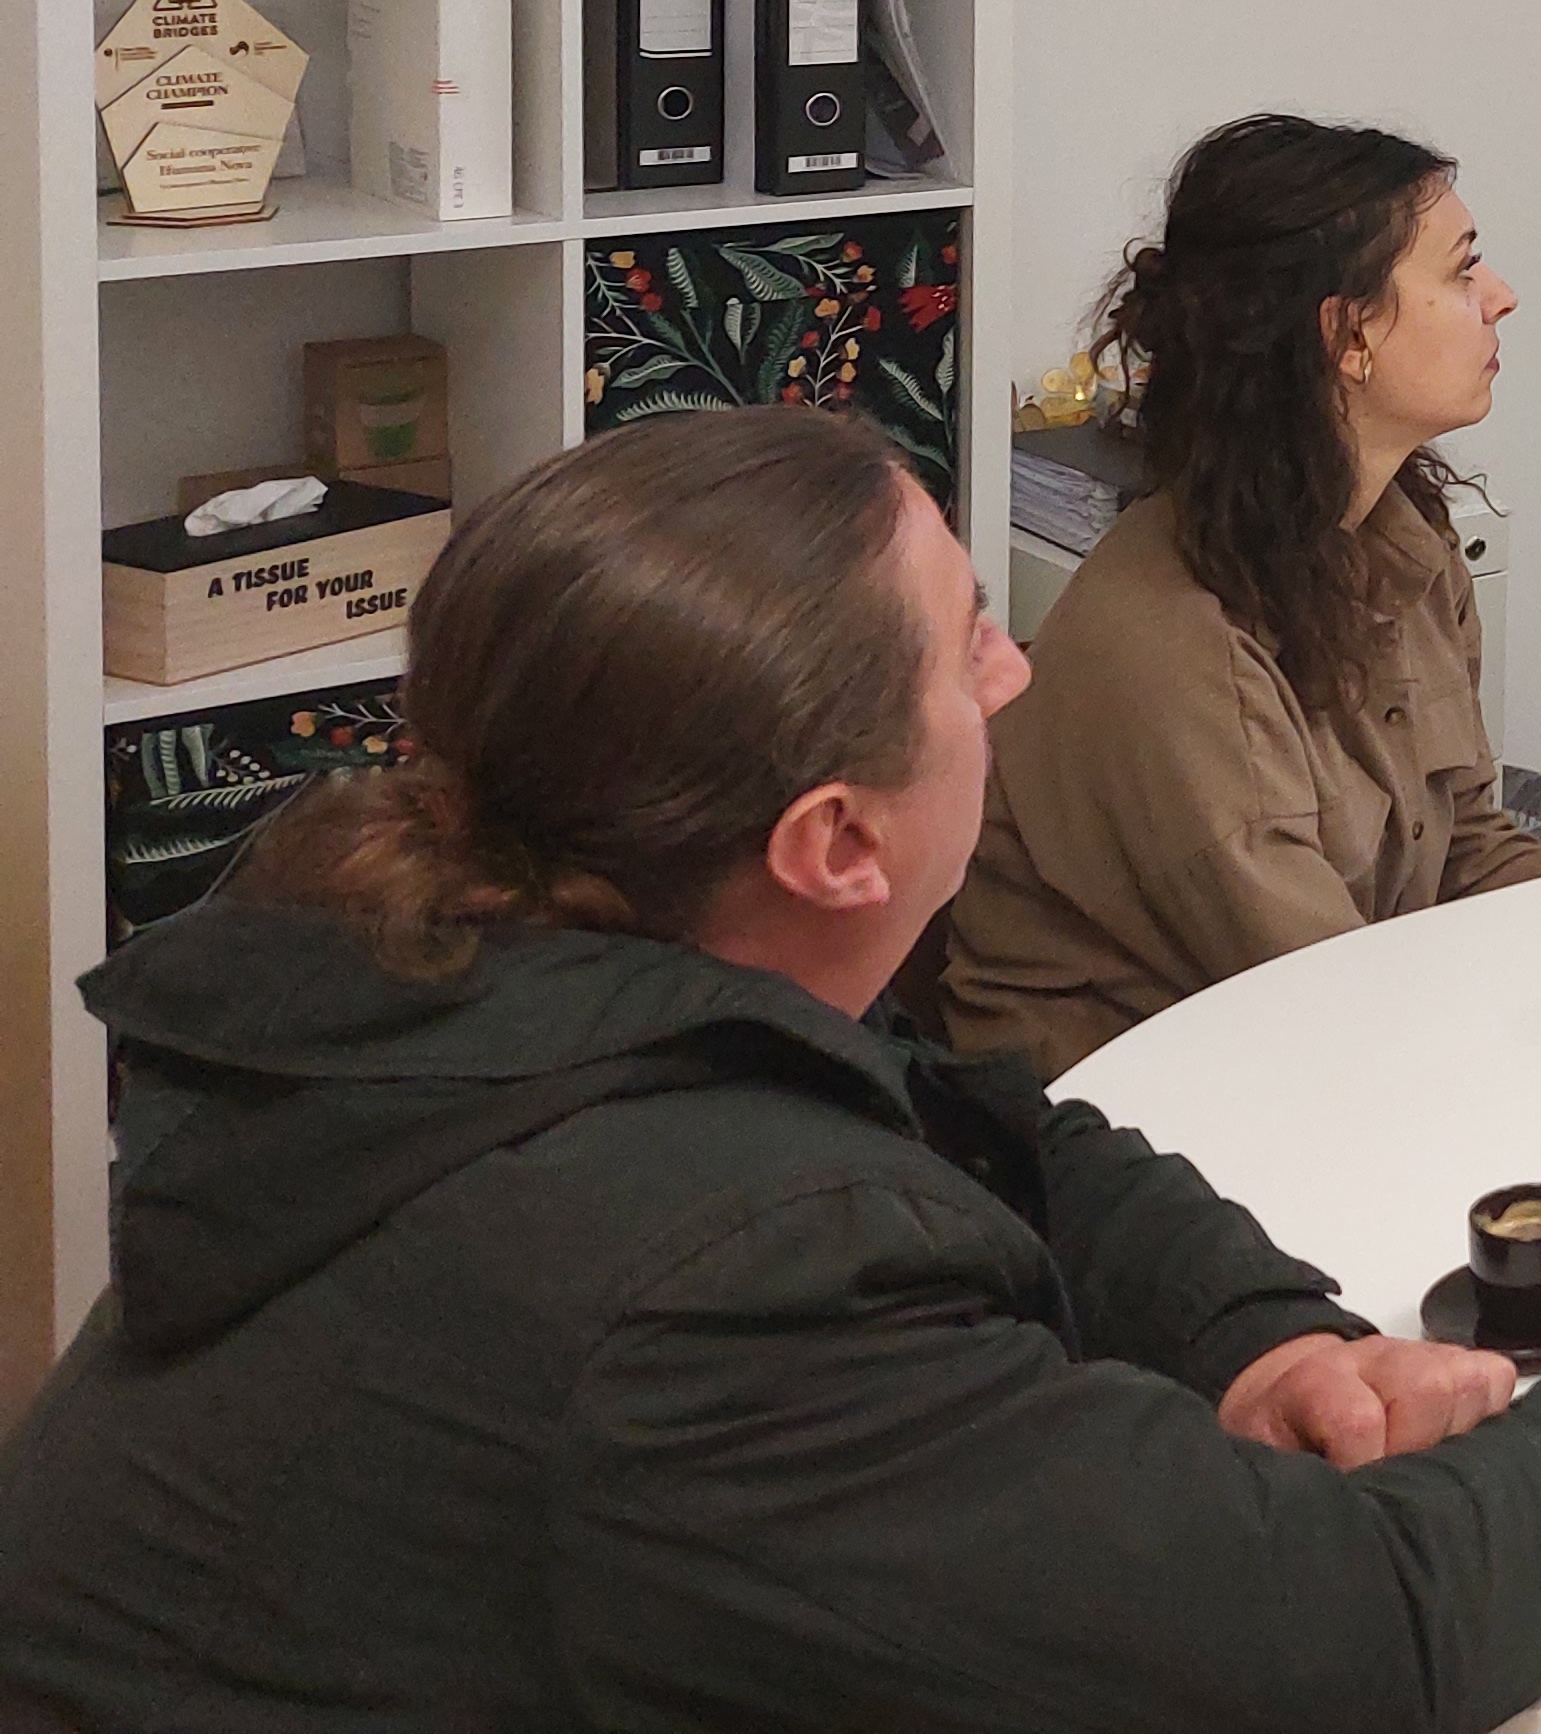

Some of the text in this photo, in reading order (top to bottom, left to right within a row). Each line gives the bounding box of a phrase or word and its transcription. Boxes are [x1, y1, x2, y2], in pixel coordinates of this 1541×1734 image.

[152, 12, 218, 28] CLIMATE
[152, 24, 219, 39] BRIDGES
[155, 71, 224, 87] CLIMATE
[145, 84, 230, 101] CHAMPION
[145, 148, 185, 161] Social
[207, 558, 311, 599] A TISSUE
[266, 570, 374, 612] FOR YOUR
[345, 587, 409, 620] ISSUE
